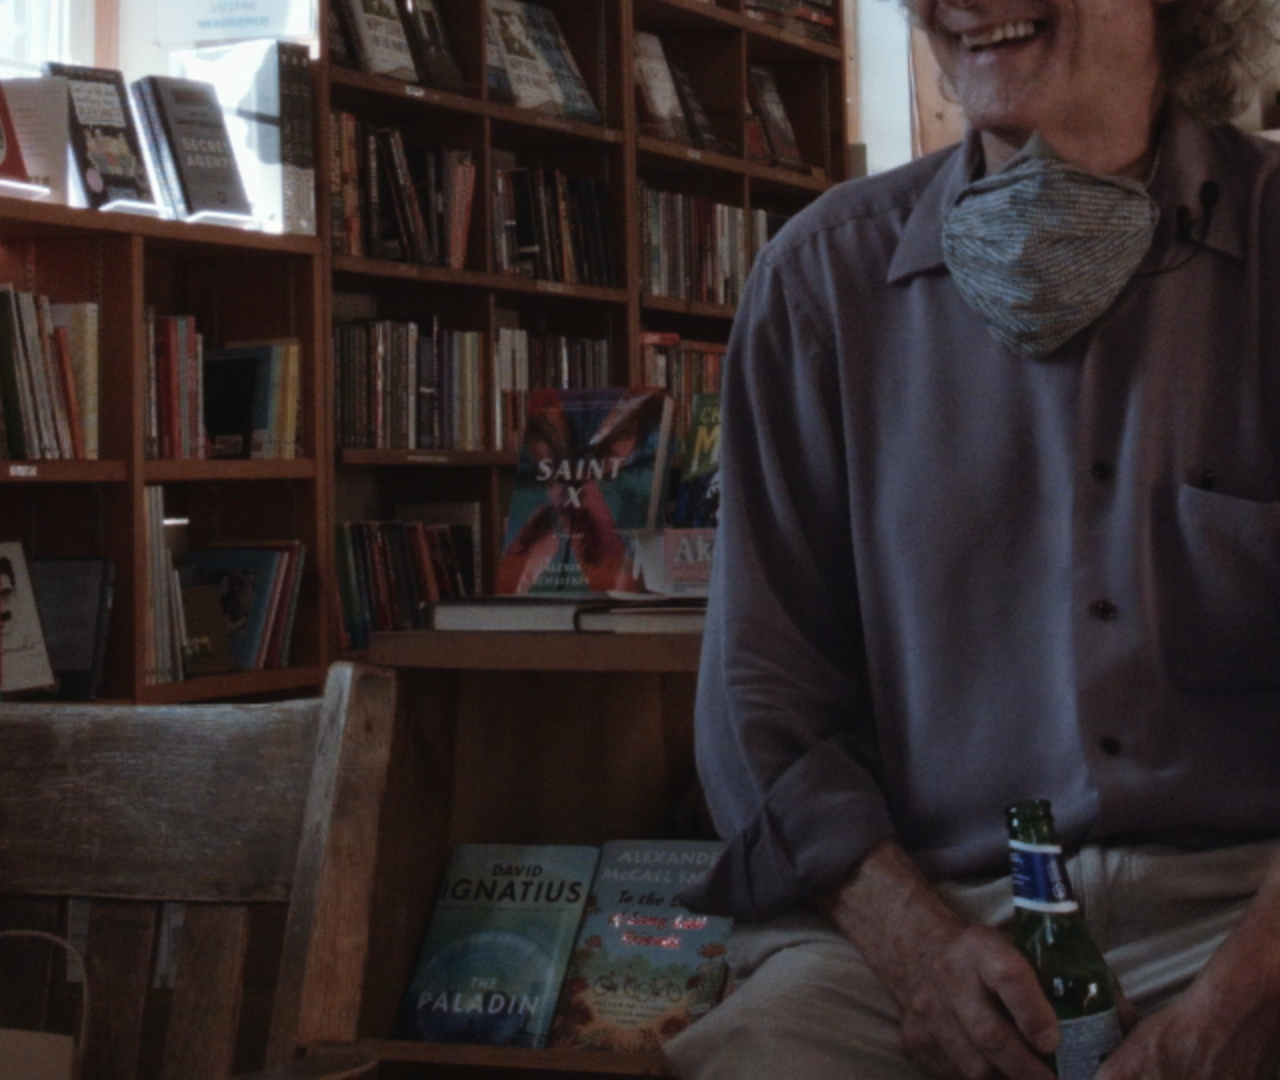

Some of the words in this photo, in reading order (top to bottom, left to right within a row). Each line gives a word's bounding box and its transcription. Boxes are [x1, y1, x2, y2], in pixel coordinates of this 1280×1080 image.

[690, 424, 721, 473] M
[536, 456, 627, 482] SAINT
[564, 486, 585, 508] X
[673, 533, 712, 563] Ak
[619, 850, 720, 867] ALEXANDE
[492, 863, 543, 878] DAVID
[678, 870, 707, 884] SM
[439, 878, 582, 904] IGNATIUS
[617, 890, 634, 906] To
[637, 891, 664, 907] the
[470, 976, 498, 990] THE
[417, 991, 542, 1016] PALADIN
